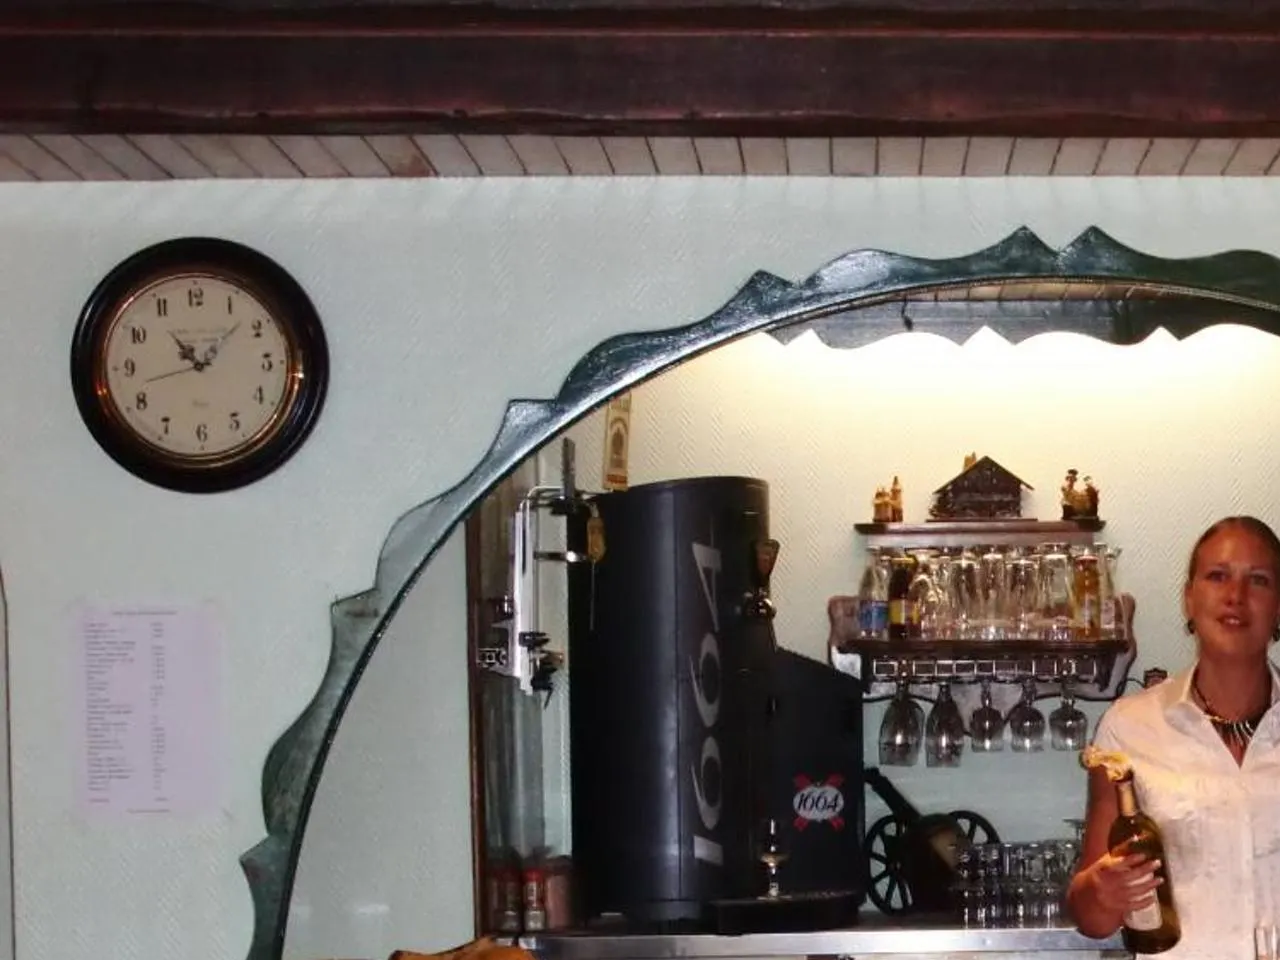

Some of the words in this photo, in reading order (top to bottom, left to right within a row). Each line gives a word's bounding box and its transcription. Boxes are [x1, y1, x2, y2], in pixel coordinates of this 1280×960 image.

[188, 288, 203, 307] 12
[157, 298, 168, 317] 11
[131, 327, 146, 344] 10
[252, 320, 262, 338] 2
[124, 359, 135, 377] 9
[262, 353, 273, 372] 3
[136, 392, 147, 410] 8
[253, 386, 263, 404] 4
[161, 416, 170, 434] 7
[230, 412, 240, 431] 5
[196, 424, 207, 442] 6
[689, 520, 724, 866] 1664
[797, 791, 840, 811] 1664
